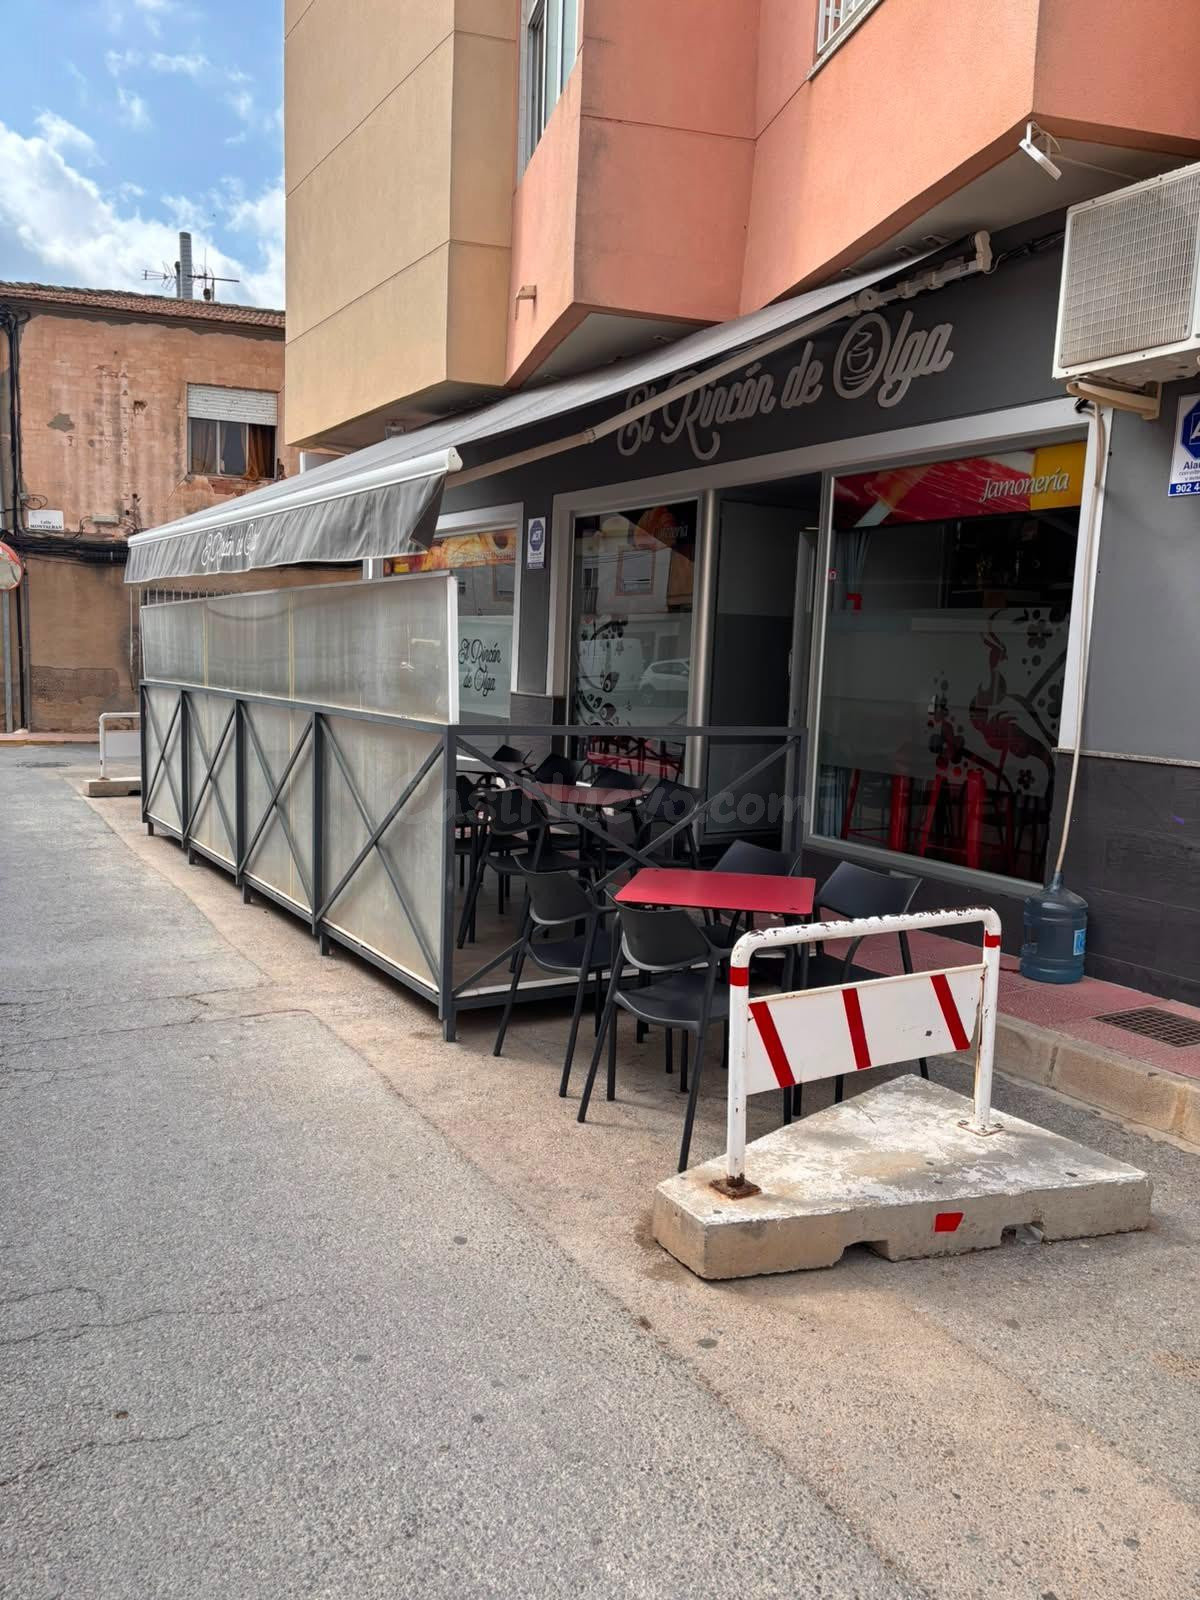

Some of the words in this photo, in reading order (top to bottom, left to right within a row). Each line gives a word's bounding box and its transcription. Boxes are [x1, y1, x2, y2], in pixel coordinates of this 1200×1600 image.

[617, 383, 656, 456] El
[661, 362, 776, 460] Rincón
[781, 340, 823, 408] de
[834, 310, 954, 408] Olga
[978, 466, 1069, 503] Jamonería
[1176, 483, 1192, 493] 902
[458, 638, 470, 664] El
[471, 639, 501, 673] Rincón
[463, 669, 472, 688] de
[474, 668, 496, 697] Olga
